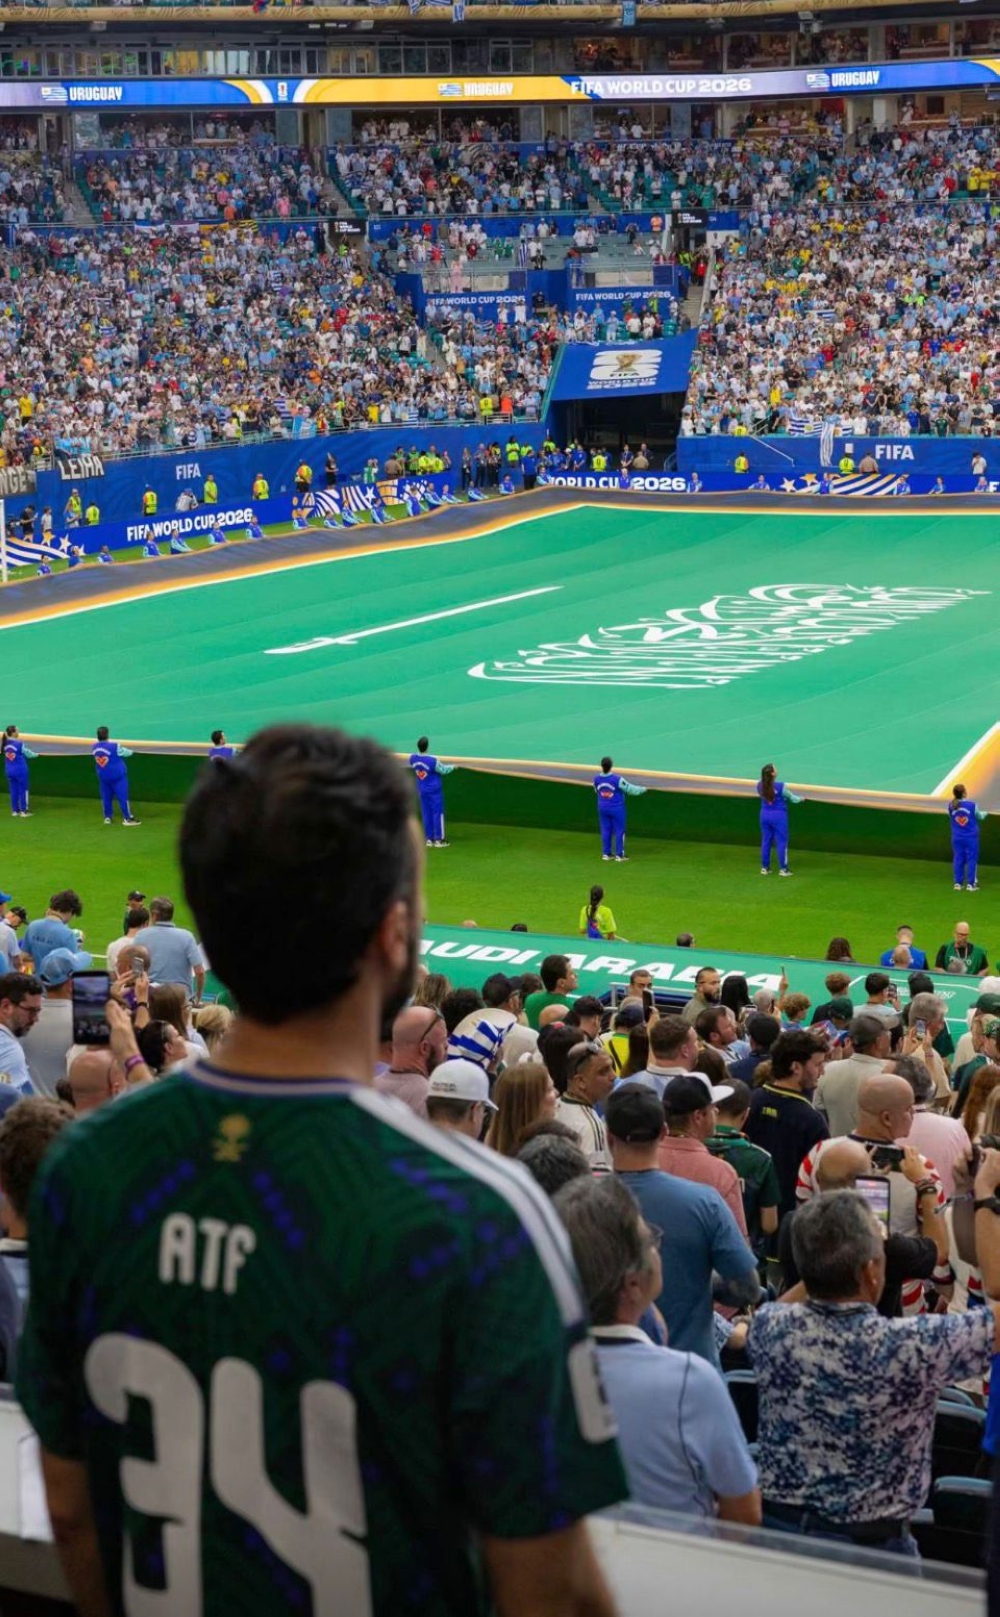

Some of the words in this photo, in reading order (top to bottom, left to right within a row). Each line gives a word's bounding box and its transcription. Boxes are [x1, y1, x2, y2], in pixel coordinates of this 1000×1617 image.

[571, 81, 603, 95] FIFA
[607, 80, 662, 94] WORLD
[666, 79, 696, 93] CUP
[699, 78, 752, 93] 2026
[832, 71, 880, 87] URUGUAY
[69, 86, 123, 101] URUGUAY
[479, 296, 495, 304] CUP
[575, 293, 594, 301] FIFA
[595, 292, 624, 300] WORLD
[875, 444, 915, 460] FIFA
[175, 463, 201, 480] FIFA
[550, 476, 597, 488] ORLD
[599, 476, 620, 489] CU
[632, 477, 686, 491] 2026
[126, 523, 151, 542] FIFA
[152, 518, 193, 538] WORLD
[194, 514, 216, 531] CUP
[217, 507, 254, 527] 2026
[419, 939, 542, 965] UDI
[84, 1331, 374, 1617] 34
